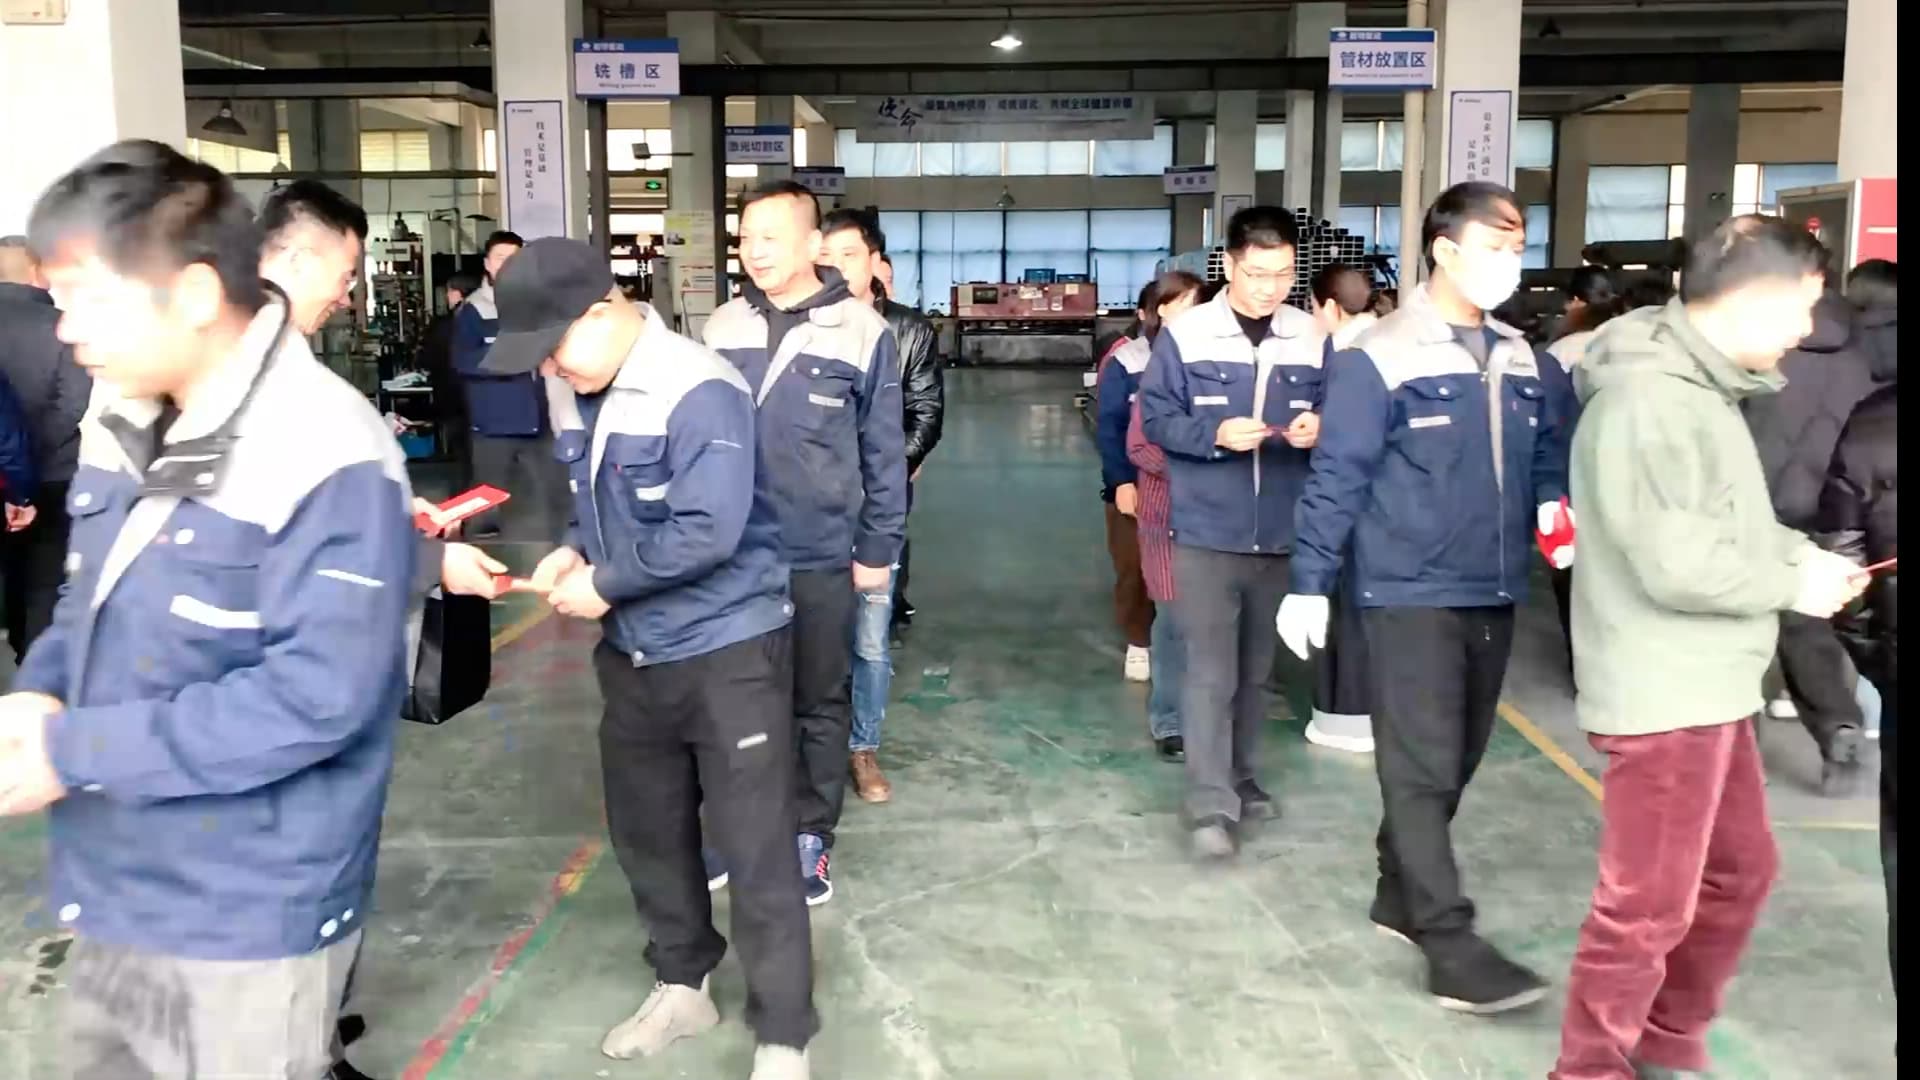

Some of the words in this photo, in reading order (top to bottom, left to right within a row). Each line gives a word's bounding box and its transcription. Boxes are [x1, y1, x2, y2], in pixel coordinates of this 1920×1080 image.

[1340, 51, 1427, 68] 管材放置区
[594, 63, 661, 79] 铣槽区
[878, 96, 924, 135] 使命
[728, 141, 784, 152] 激光切割区
